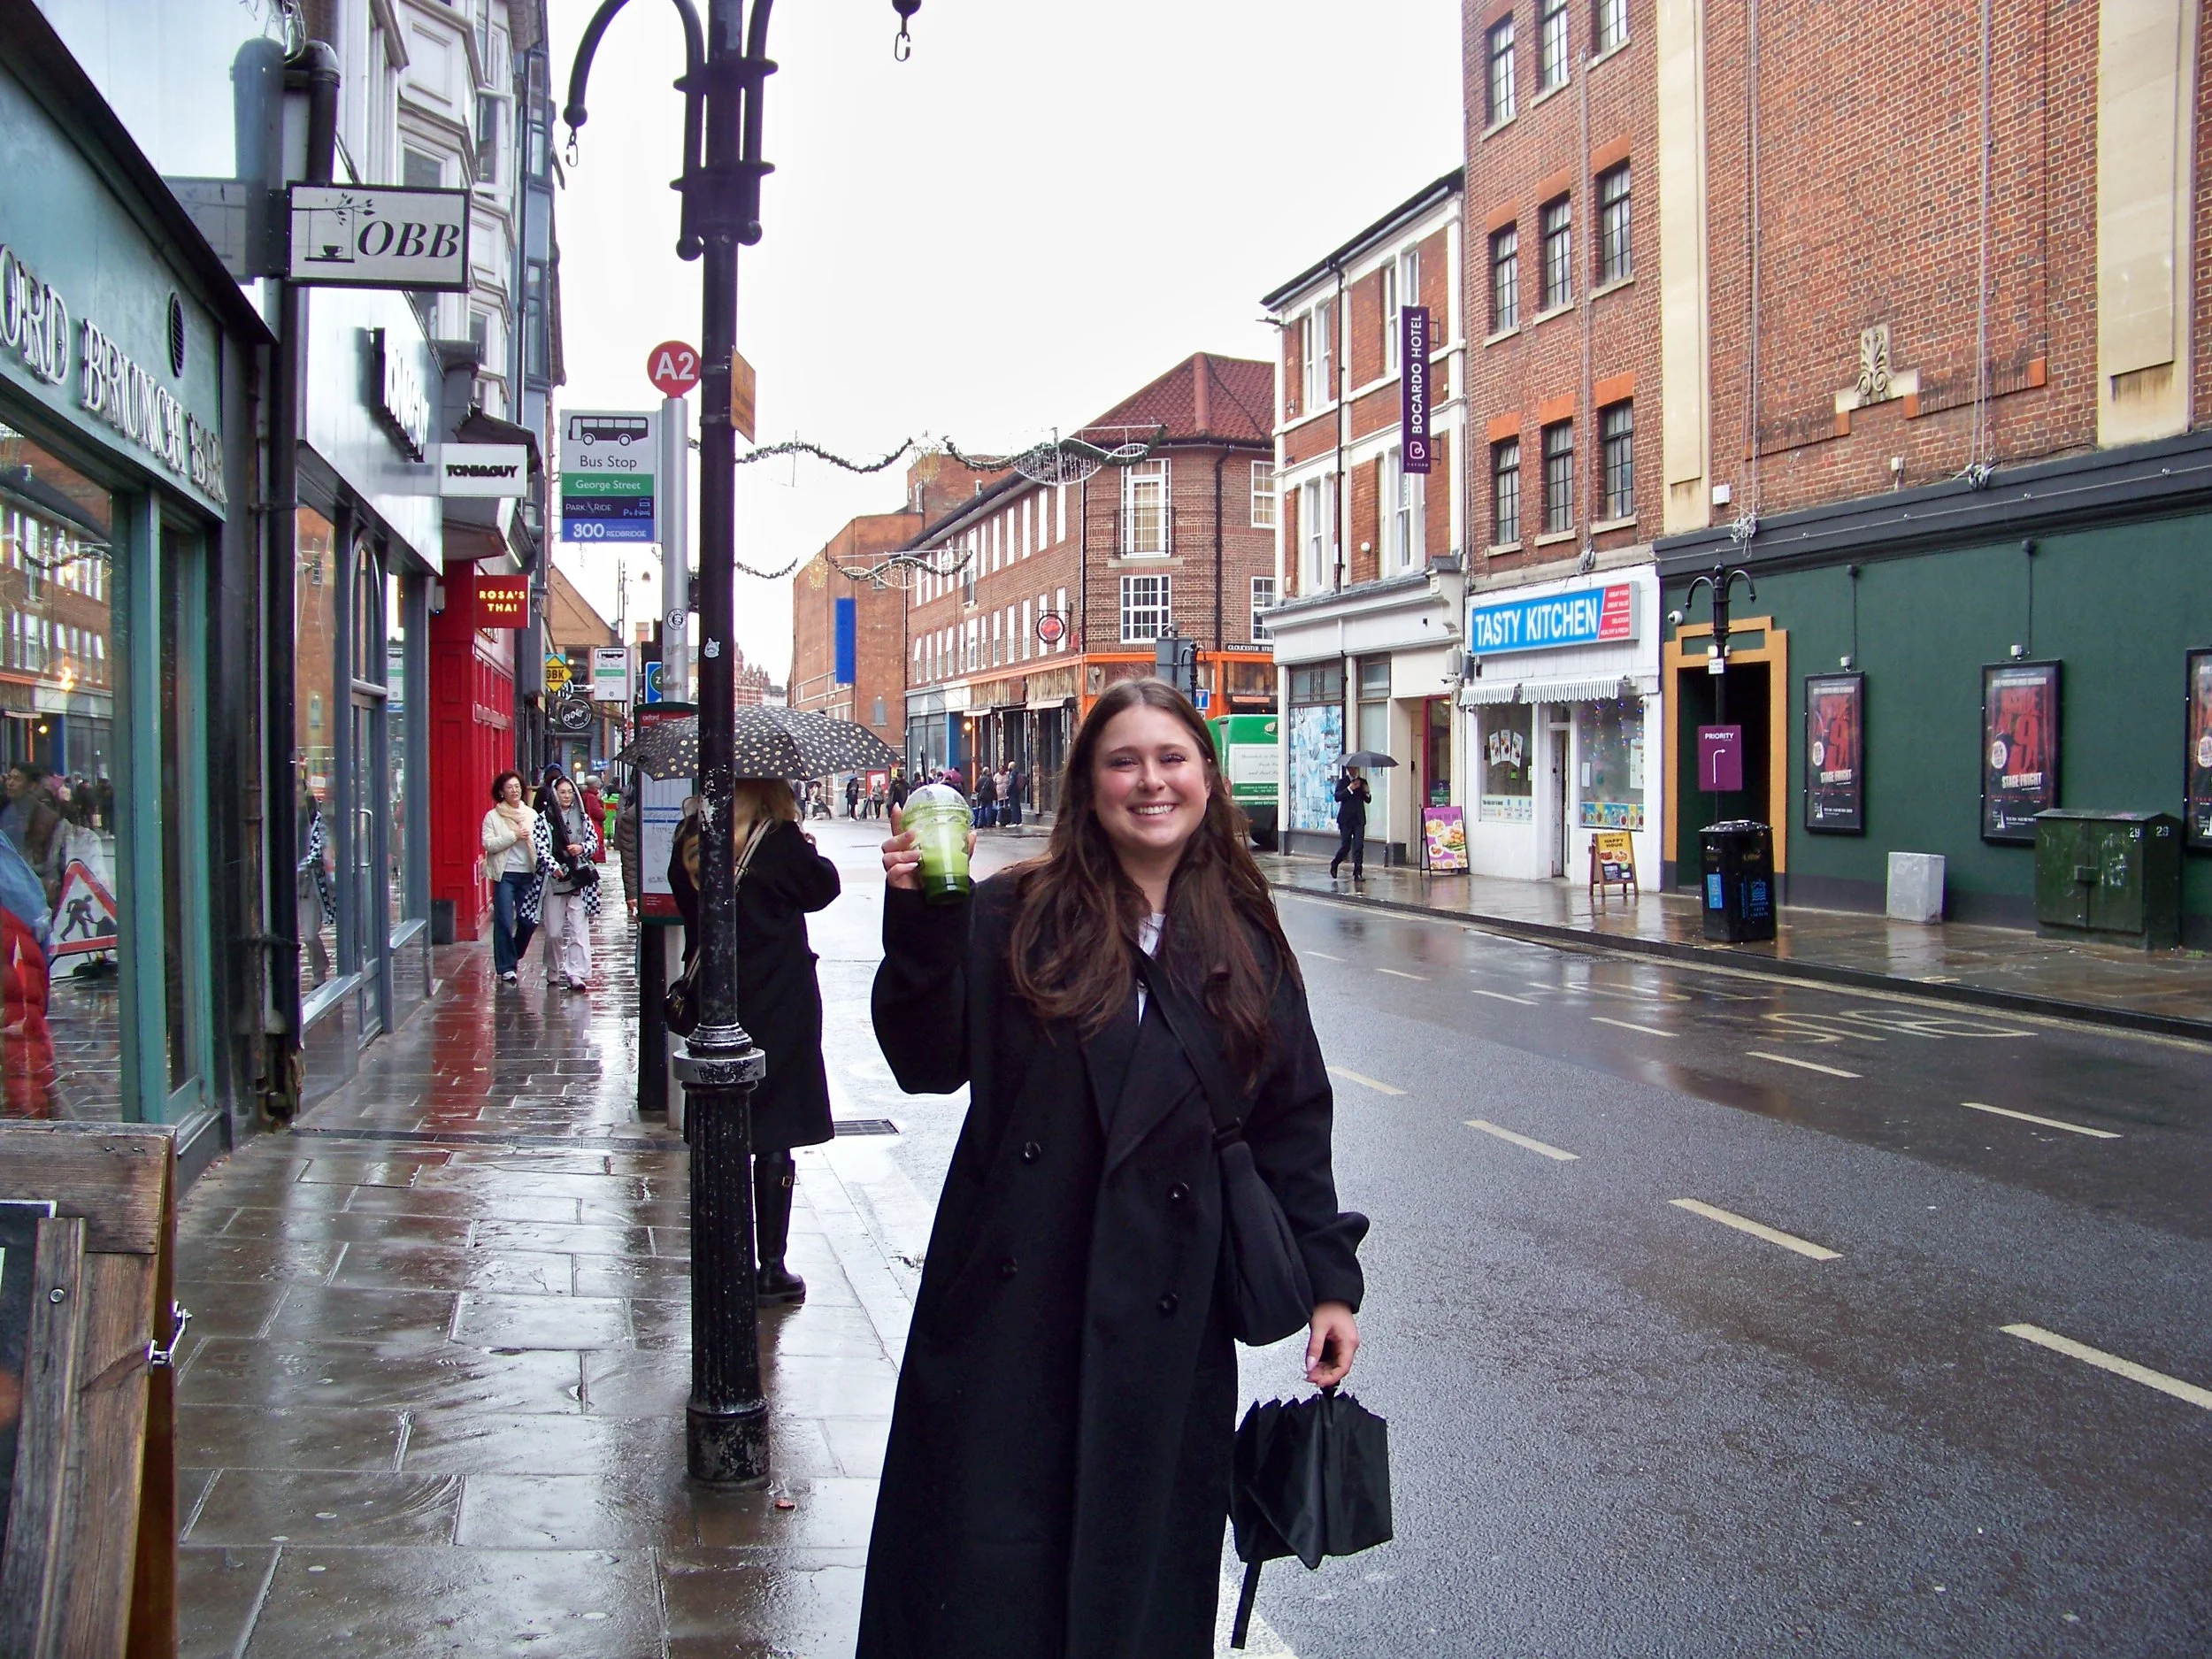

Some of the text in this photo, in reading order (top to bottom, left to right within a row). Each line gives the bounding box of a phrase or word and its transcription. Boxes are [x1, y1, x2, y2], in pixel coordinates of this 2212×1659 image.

[357, 220, 460, 258] OBB
[655, 352, 695, 380] A2
[1410, 315, 1423, 434] BOCARDO HOTEL
[81, 319, 187, 475] BRUNCH
[580, 455, 637, 471] Bus Stop
[575, 480, 641, 491] George Street
[573, 523, 604, 538] 300
[479, 590, 525, 600] ROSA'S
[488, 603, 517, 612] THAI
[1476, 597, 1597, 646] TASTY KITCHEN
[2001, 774, 2019, 789] STAGE
